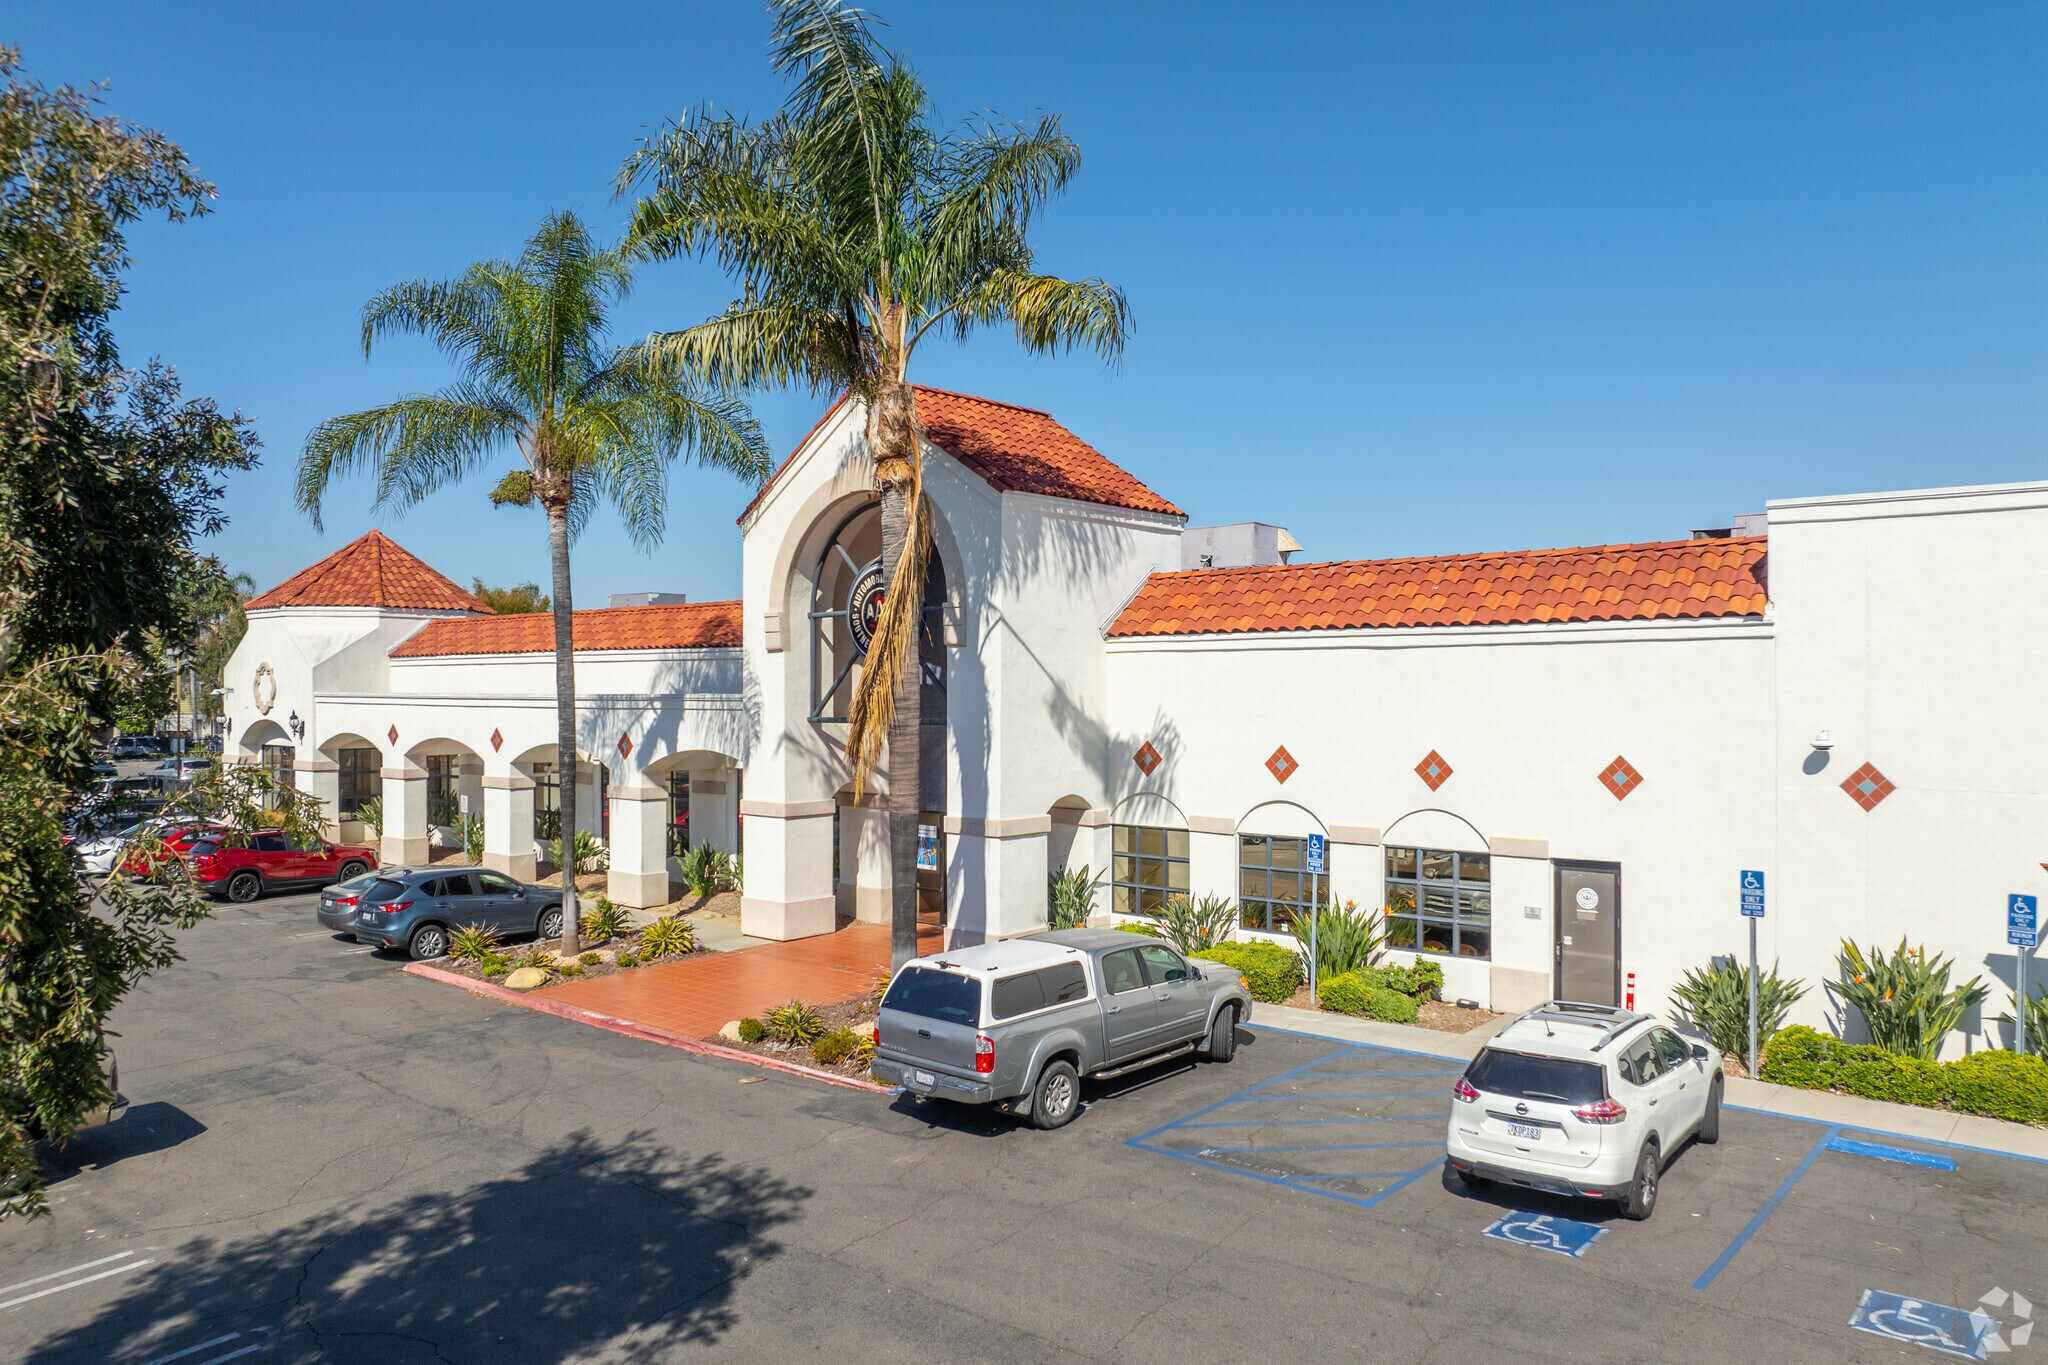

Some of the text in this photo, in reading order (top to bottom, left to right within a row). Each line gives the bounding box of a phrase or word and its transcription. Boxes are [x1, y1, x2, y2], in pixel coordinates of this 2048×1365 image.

[853, 574, 884, 608] AUTOMOBI
[866, 600, 883, 622] AA
[852, 613, 870, 648] SOUTHE
[1741, 888, 1764, 896] PARKING
[1744, 895, 1760, 903] ONLY
